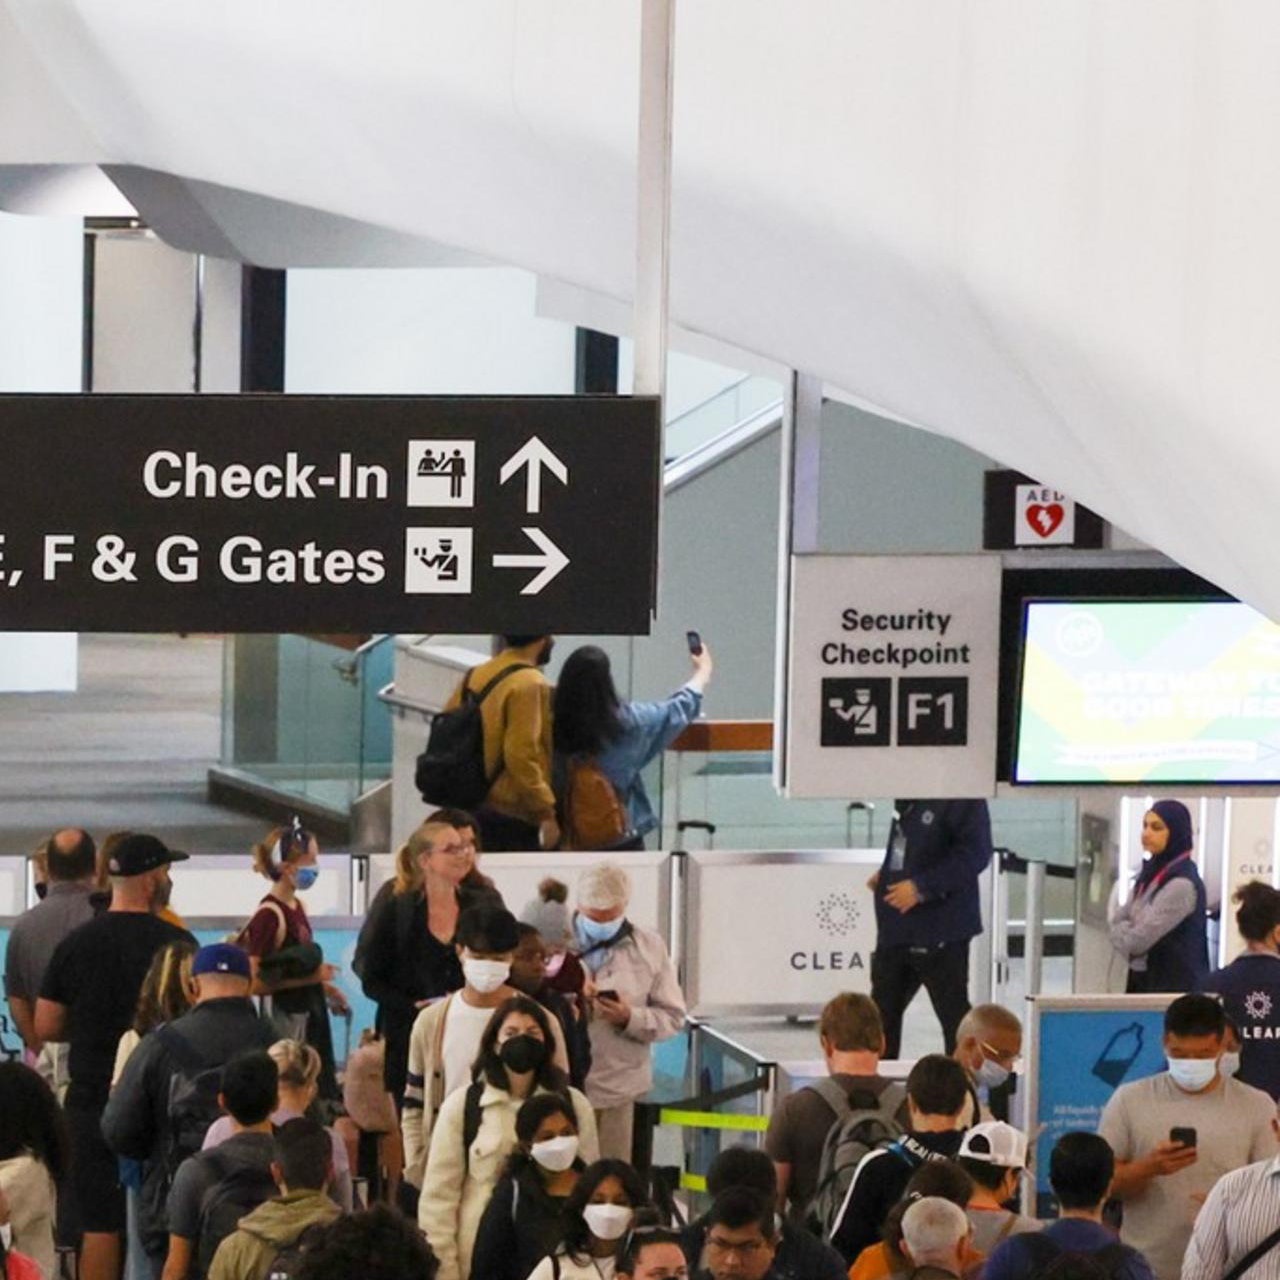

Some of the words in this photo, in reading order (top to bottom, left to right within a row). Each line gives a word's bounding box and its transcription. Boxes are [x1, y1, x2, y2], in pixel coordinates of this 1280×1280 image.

[143, 450, 388, 499] Check-In
[43, 535, 75, 581] F
[91, 534, 138, 582] &
[156, 535, 199, 582] G
[219, 536, 385, 584] Gates
[841, 608, 952, 636] Security
[821, 641, 971, 669] Checkpoint
[907, 693, 954, 729] F1
[790, 951, 865, 971] CLEA
